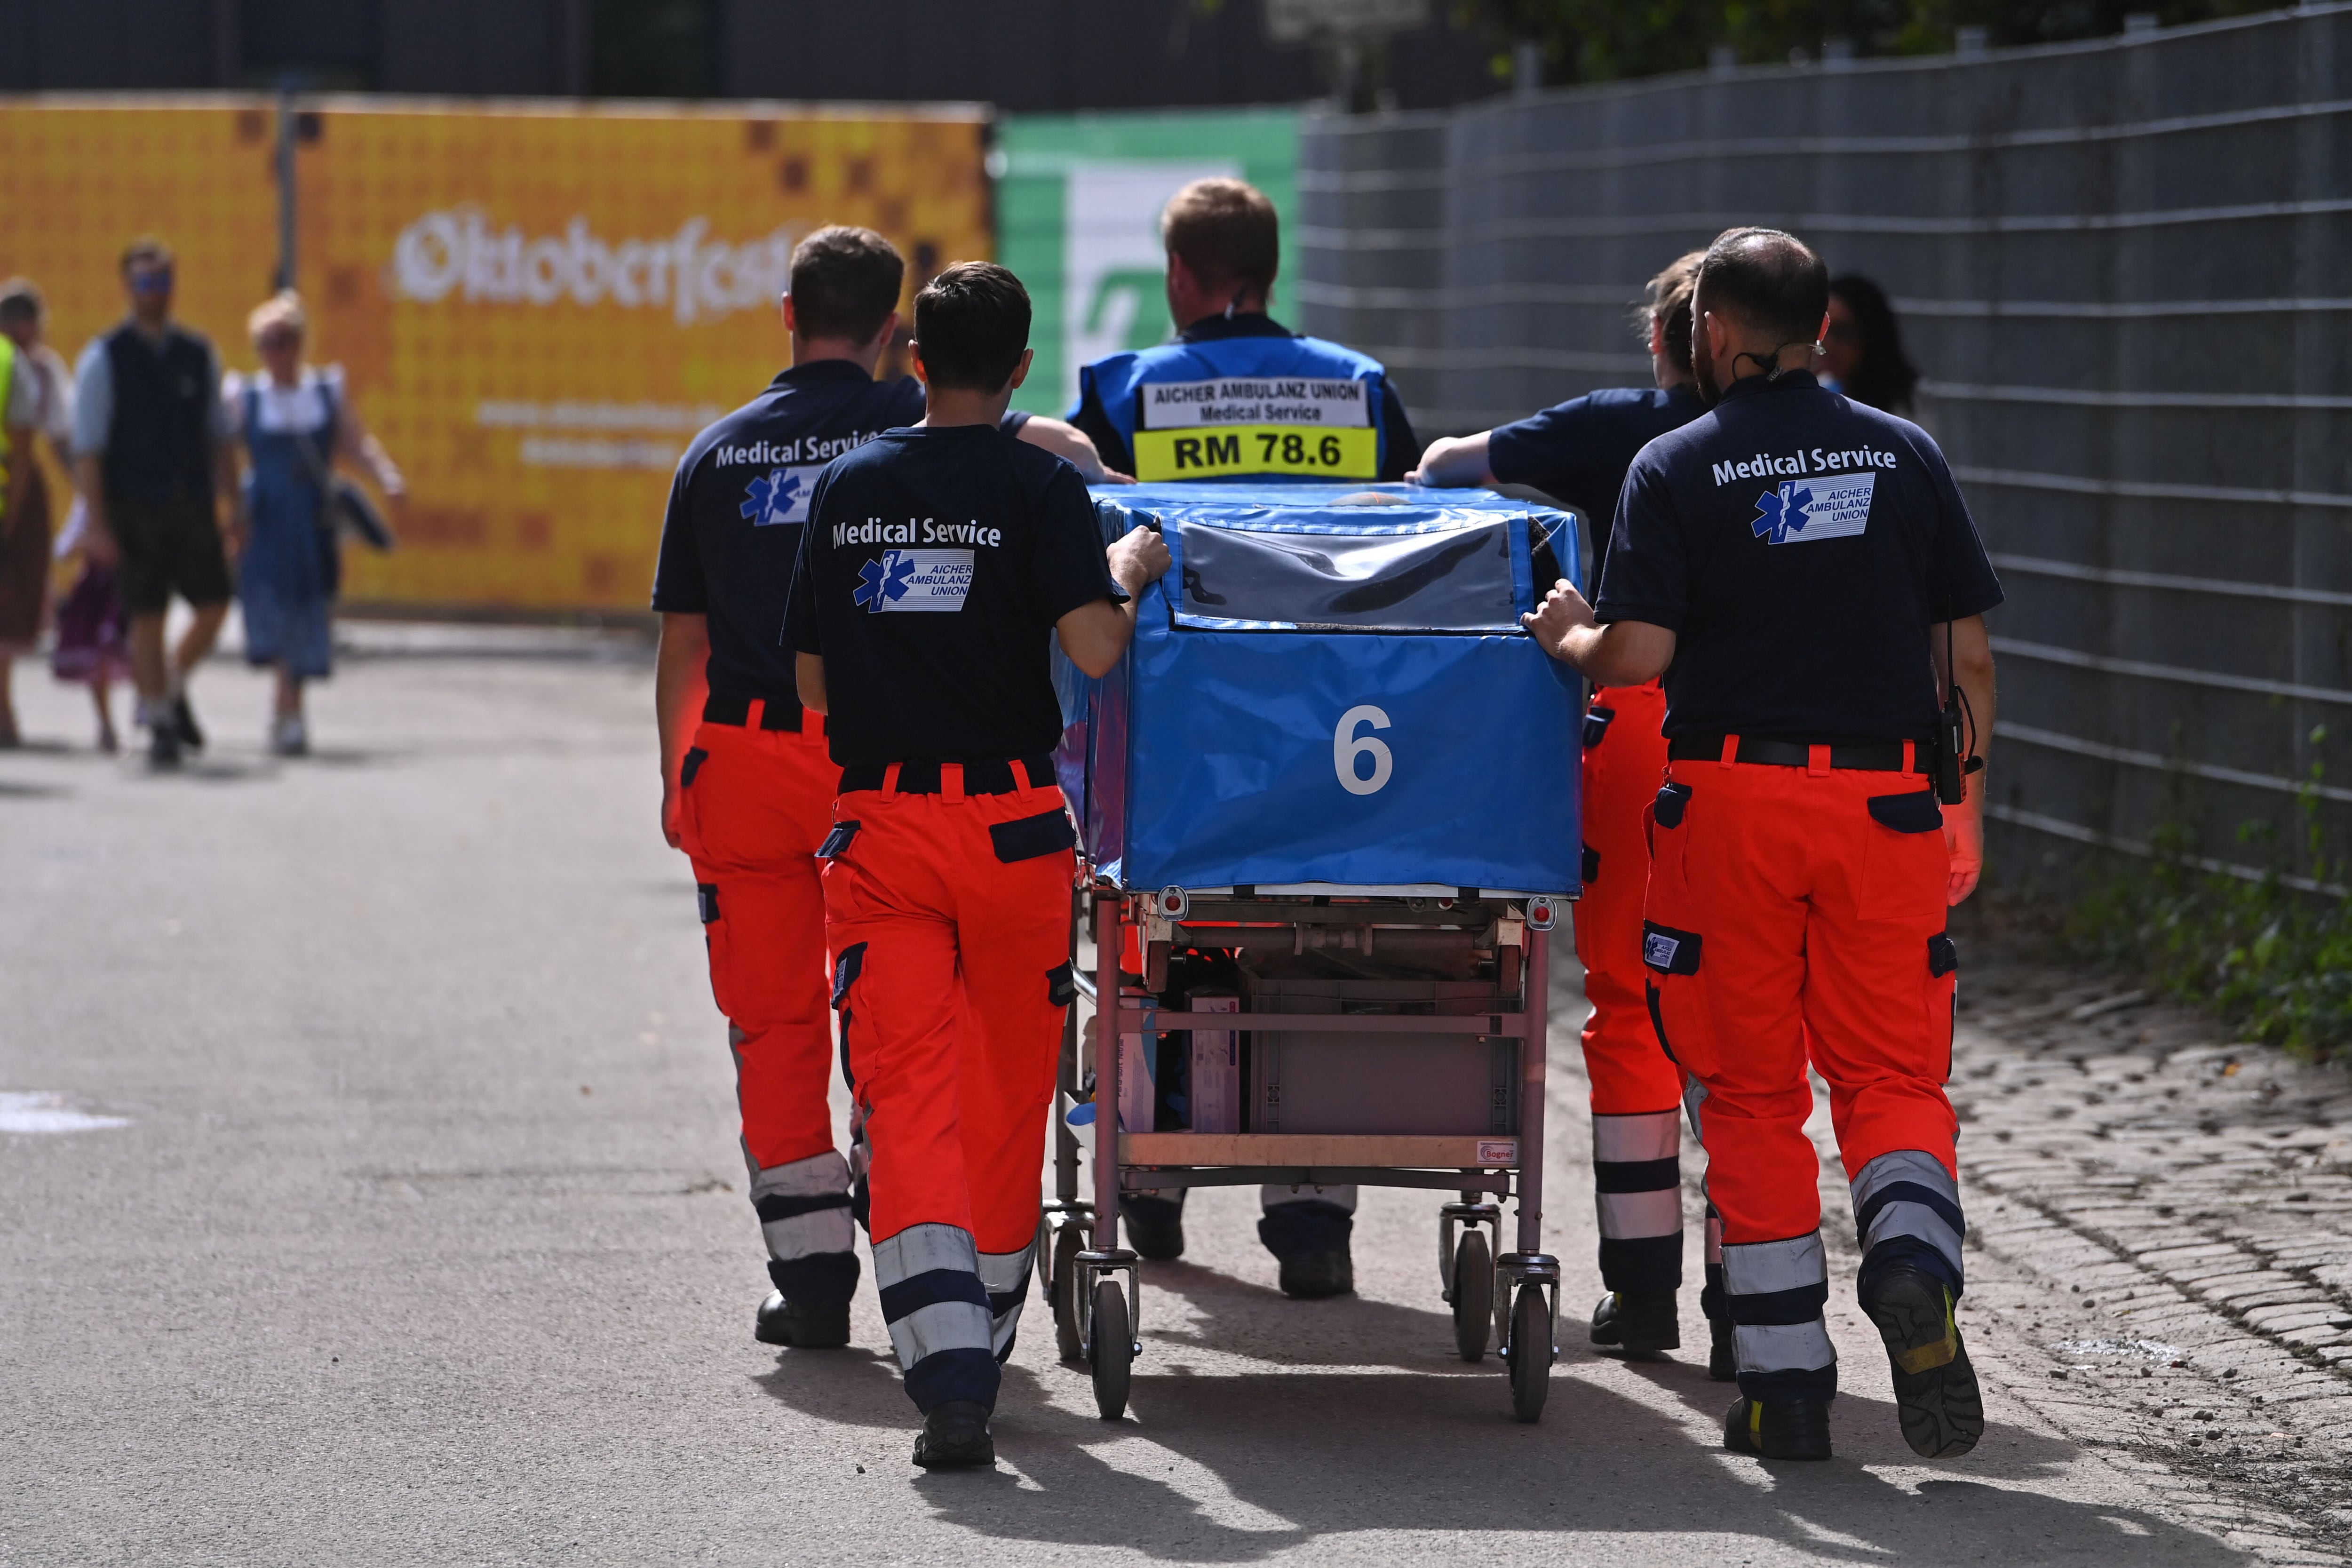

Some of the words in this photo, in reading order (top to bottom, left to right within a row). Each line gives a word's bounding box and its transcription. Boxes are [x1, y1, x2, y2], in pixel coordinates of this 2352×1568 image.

[1155, 386, 1216, 404] AICHER
[1220, 381, 1306, 400] AMBULANZ
[1310, 382, 1360, 401] UNION
[1200, 404, 1261, 422] Medical
[1264, 403, 1322, 421] Service
[716, 438, 800, 469] Medical
[1173, 434, 1241, 470] RM
[1256, 433, 1342, 467] 78.6
[1712, 449, 1807, 487] Medical
[1811, 444, 1897, 472] Service
[1828, 486, 1871, 501] AICHER
[1806, 497, 1870, 514] AMBULANZ
[1831, 508, 1868, 522] UNION
[833, 517, 916, 550] Medical
[922, 517, 1001, 547] Service
[930, 565, 972, 574] AICHER
[906, 575, 971, 585] AMBULANZ
[930, 586, 969, 596] UNION
[1334, 705, 1393, 796] 6
[1486, 1150, 1514, 1159] Bogner
